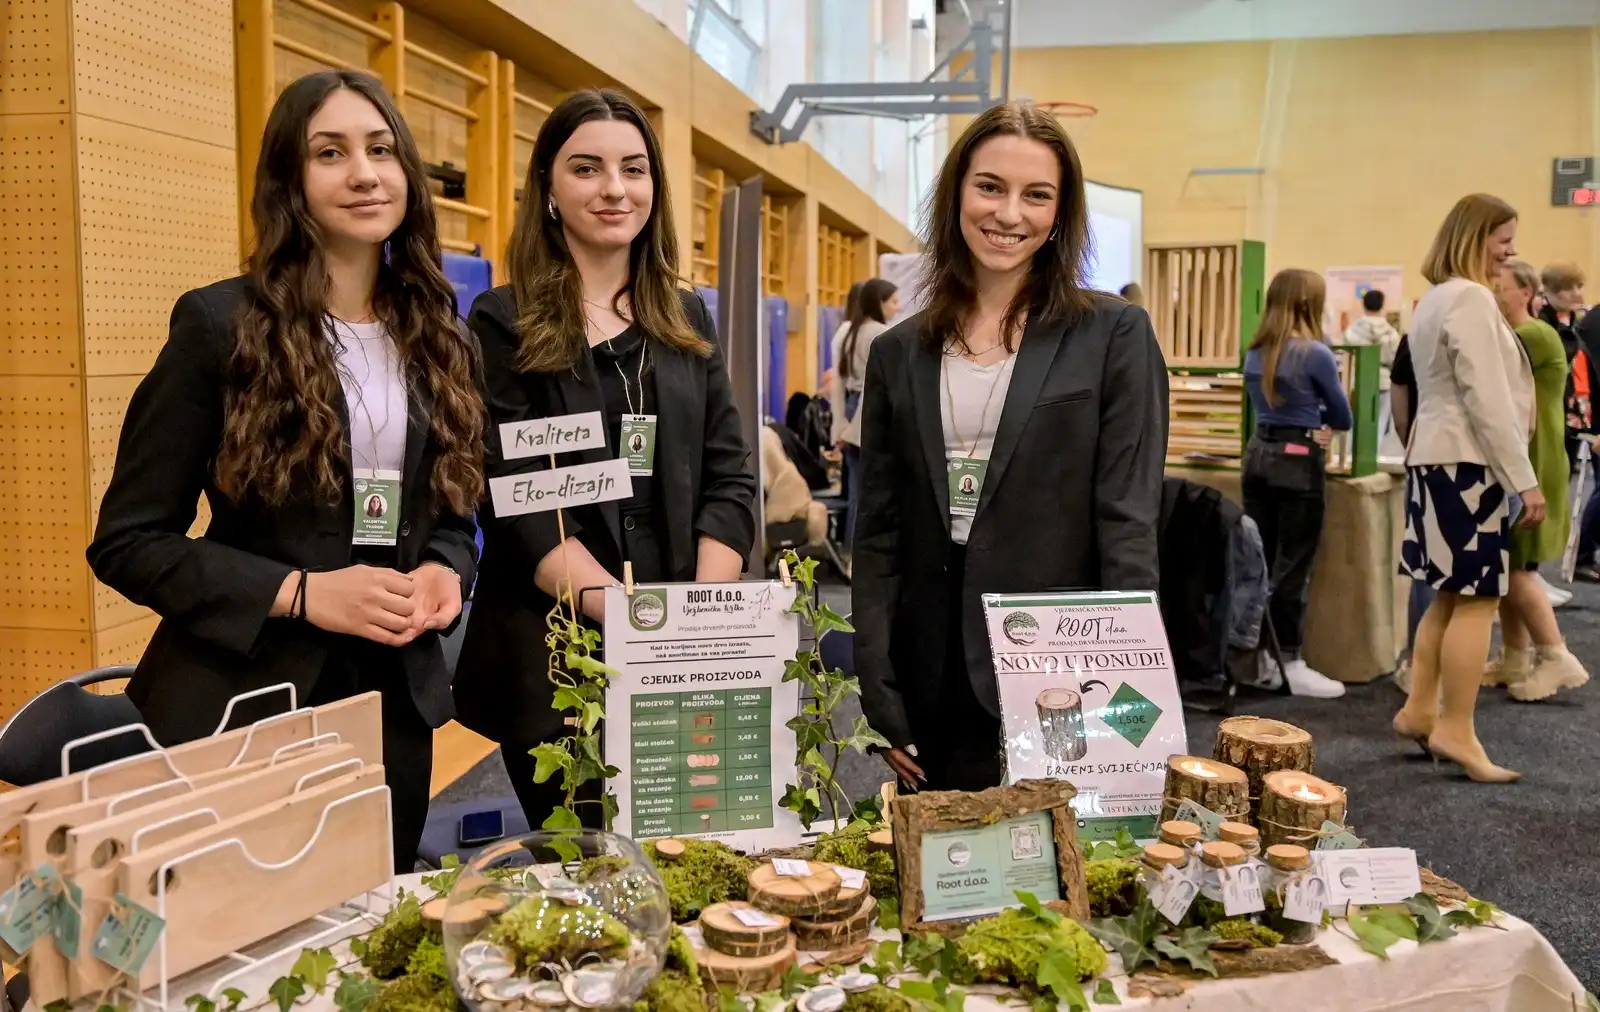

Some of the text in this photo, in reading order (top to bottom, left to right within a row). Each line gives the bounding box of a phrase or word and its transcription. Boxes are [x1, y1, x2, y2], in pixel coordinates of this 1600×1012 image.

[512, 472, 615, 506] Eko-dizajn
[687, 590, 745, 603] ROOT d.o.o.
[677, 625, 701, 633] Prodaja
[726, 623, 756, 632] proizvoda
[1055, 615, 1114, 640] ROOT
[1000, 652, 1166, 671] NOVO U PONUDI!
[640, 670, 762, 685] CJENIK PROIZVODA
[733, 693, 761, 702] CIJENA
[635, 699, 675, 708] PROIZVOD
[681, 699, 725, 708] PROIZVODA
[1118, 715, 1146, 726] 1,50€
[634, 740, 649, 748] Mali
[633, 777, 655, 785] Velika
[635, 798, 652, 806] Mala
[936, 876, 989, 890] Root d.o.o.
